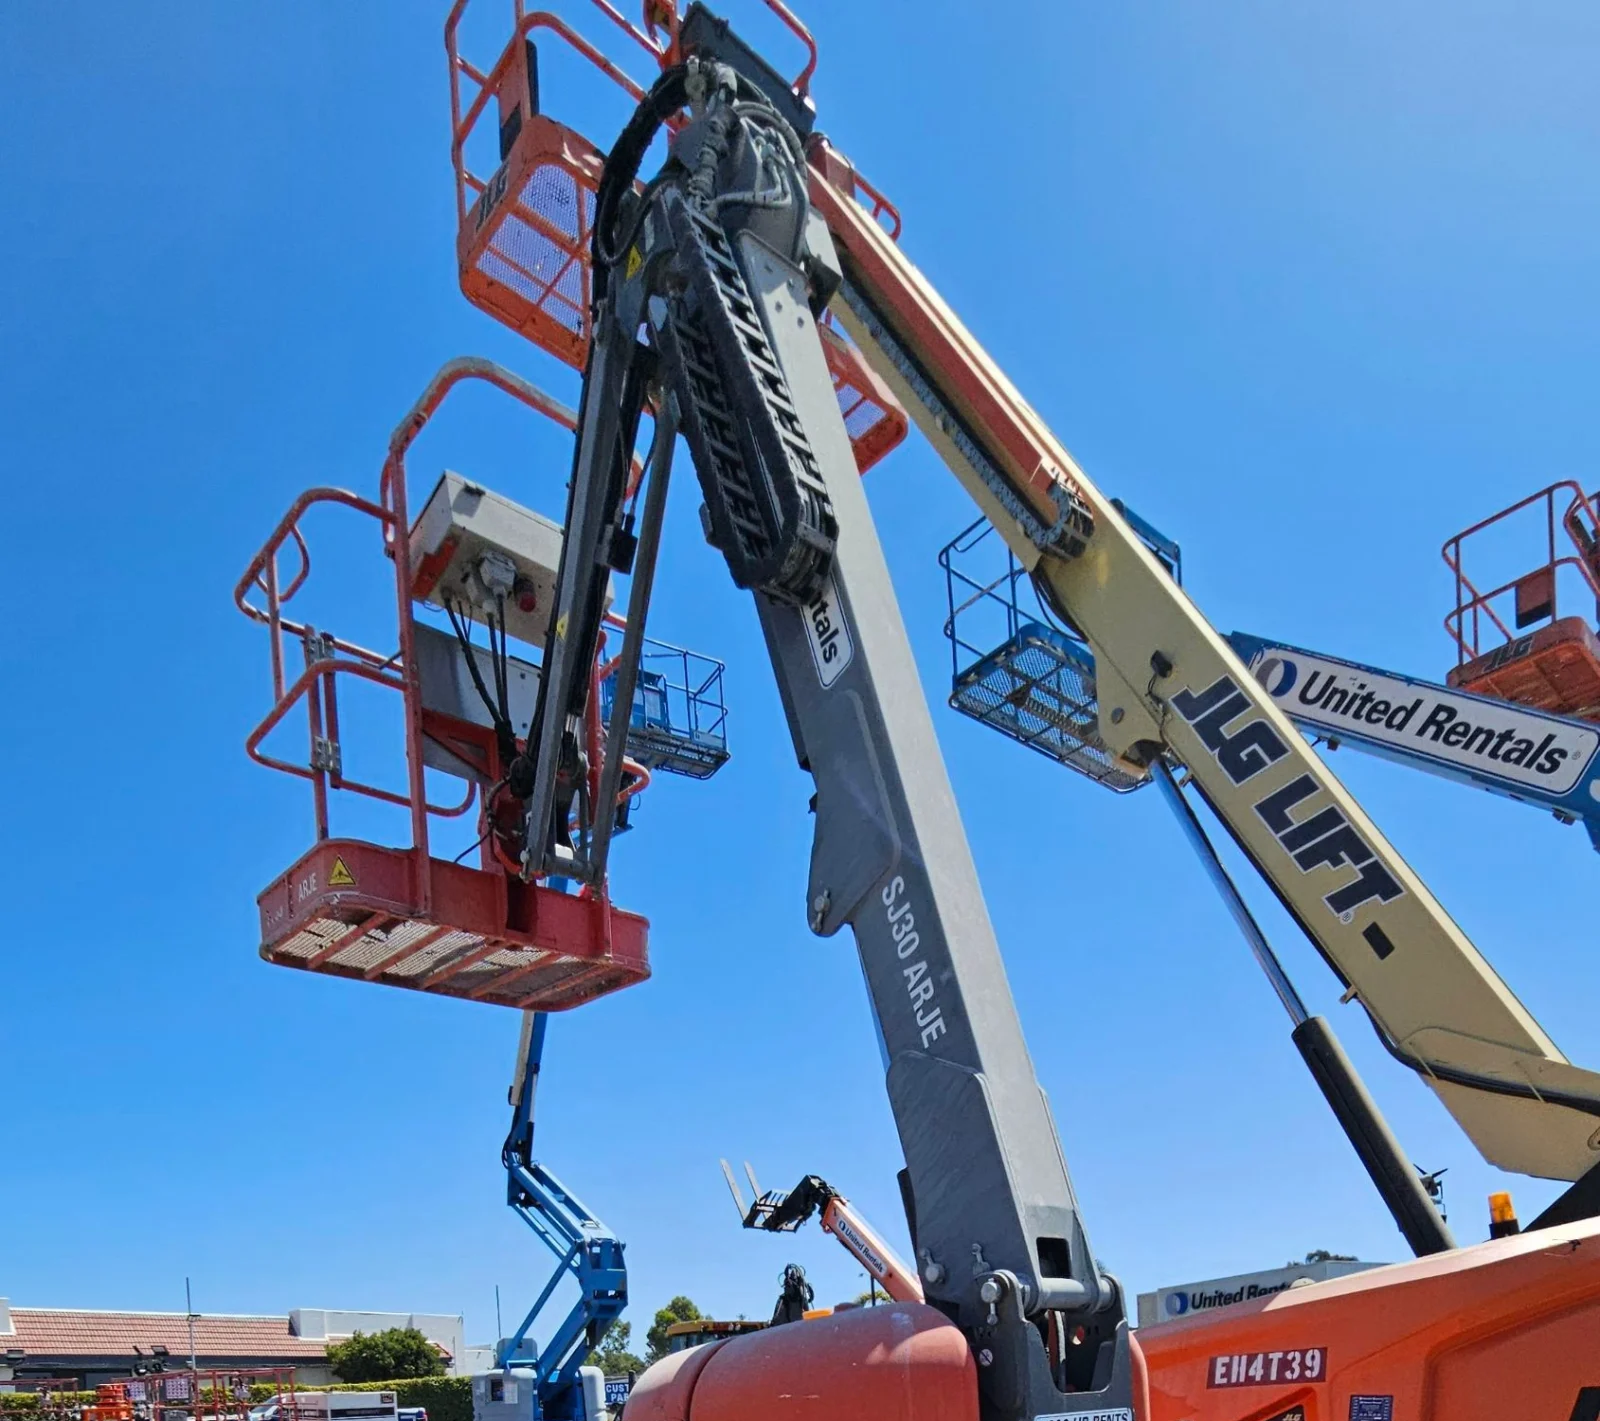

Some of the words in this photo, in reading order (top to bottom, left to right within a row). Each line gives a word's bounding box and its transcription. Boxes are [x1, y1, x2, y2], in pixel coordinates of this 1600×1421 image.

[809, 599, 840, 664] tals
[1482, 635, 1534, 673] JLG
[1298, 670, 1421, 732] United
[1415, 702, 1568, 775] Rentals
[1169, 673, 1293, 788] JLG
[1252, 771, 1409, 918] LIFT
[882, 875, 920, 960] SJ30
[903, 960, 947, 1049] ARJE
[845, 1228, 865, 1251] United
[862, 1247, 883, 1273] Rentals
[1191, 1286, 1244, 1310] United
[1214, 1349, 1322, 1385] EH4T39
[1282, 1413, 1302, 1421] JLG
